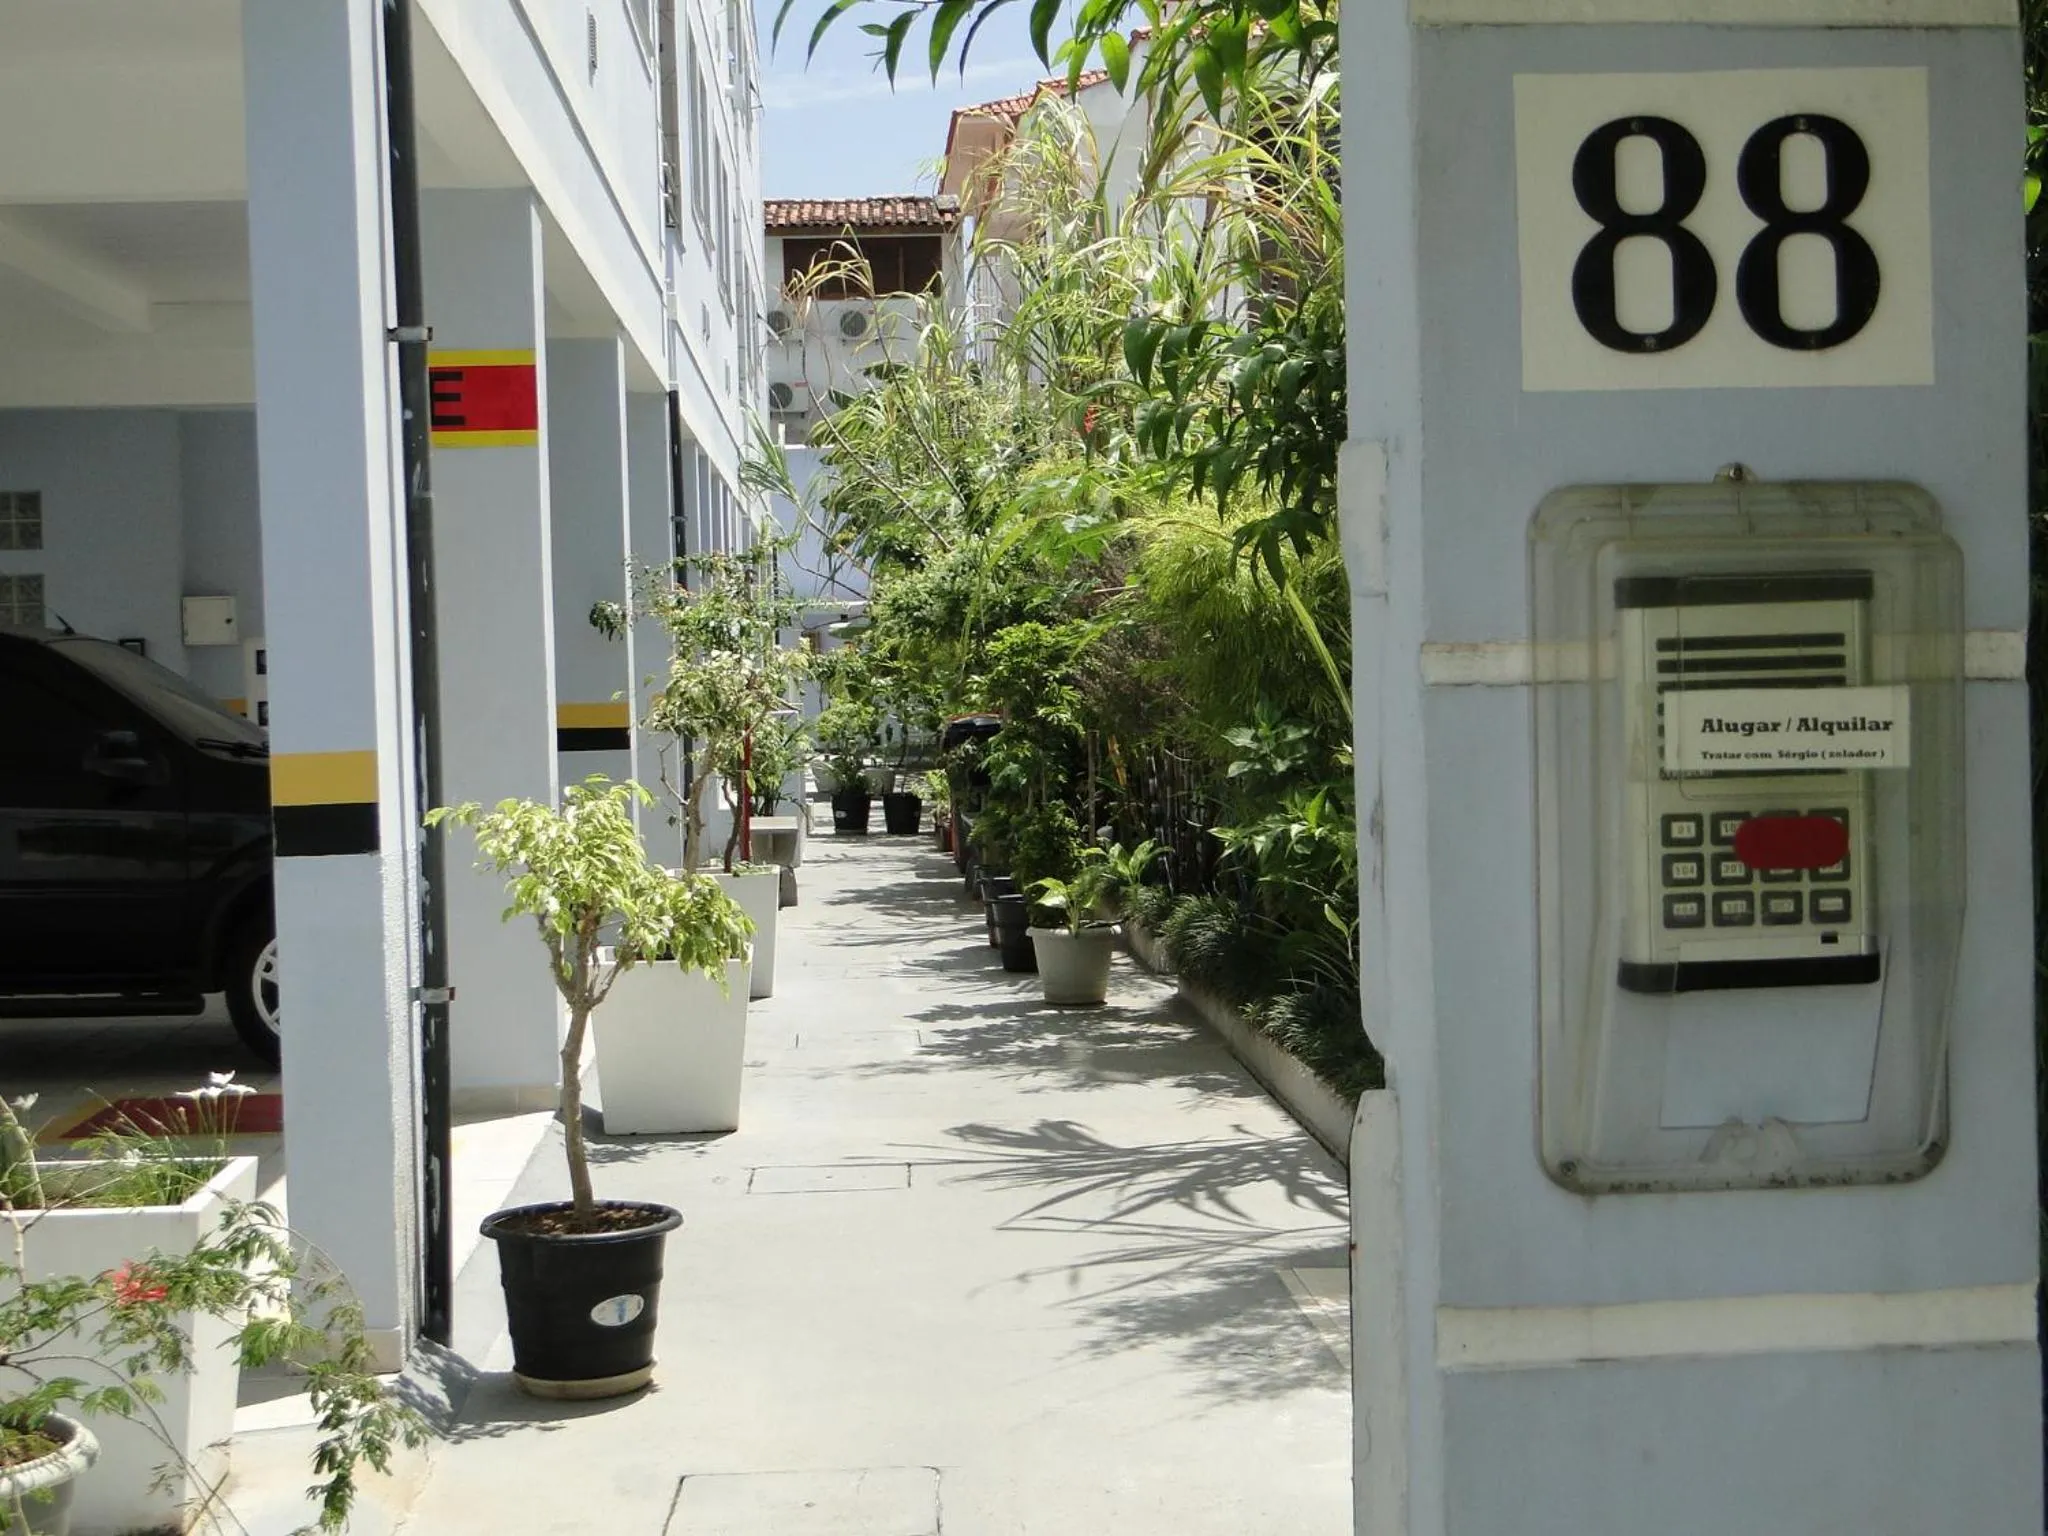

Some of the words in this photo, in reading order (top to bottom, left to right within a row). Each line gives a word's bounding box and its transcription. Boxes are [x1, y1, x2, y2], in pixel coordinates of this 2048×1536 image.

[1571, 113, 1880, 353] 88
[429, 371, 465, 426] E
[1701, 718, 1782, 737] Alugar
[1796, 717, 1893, 736] Alquilar
[1744, 752, 1773, 760] com
